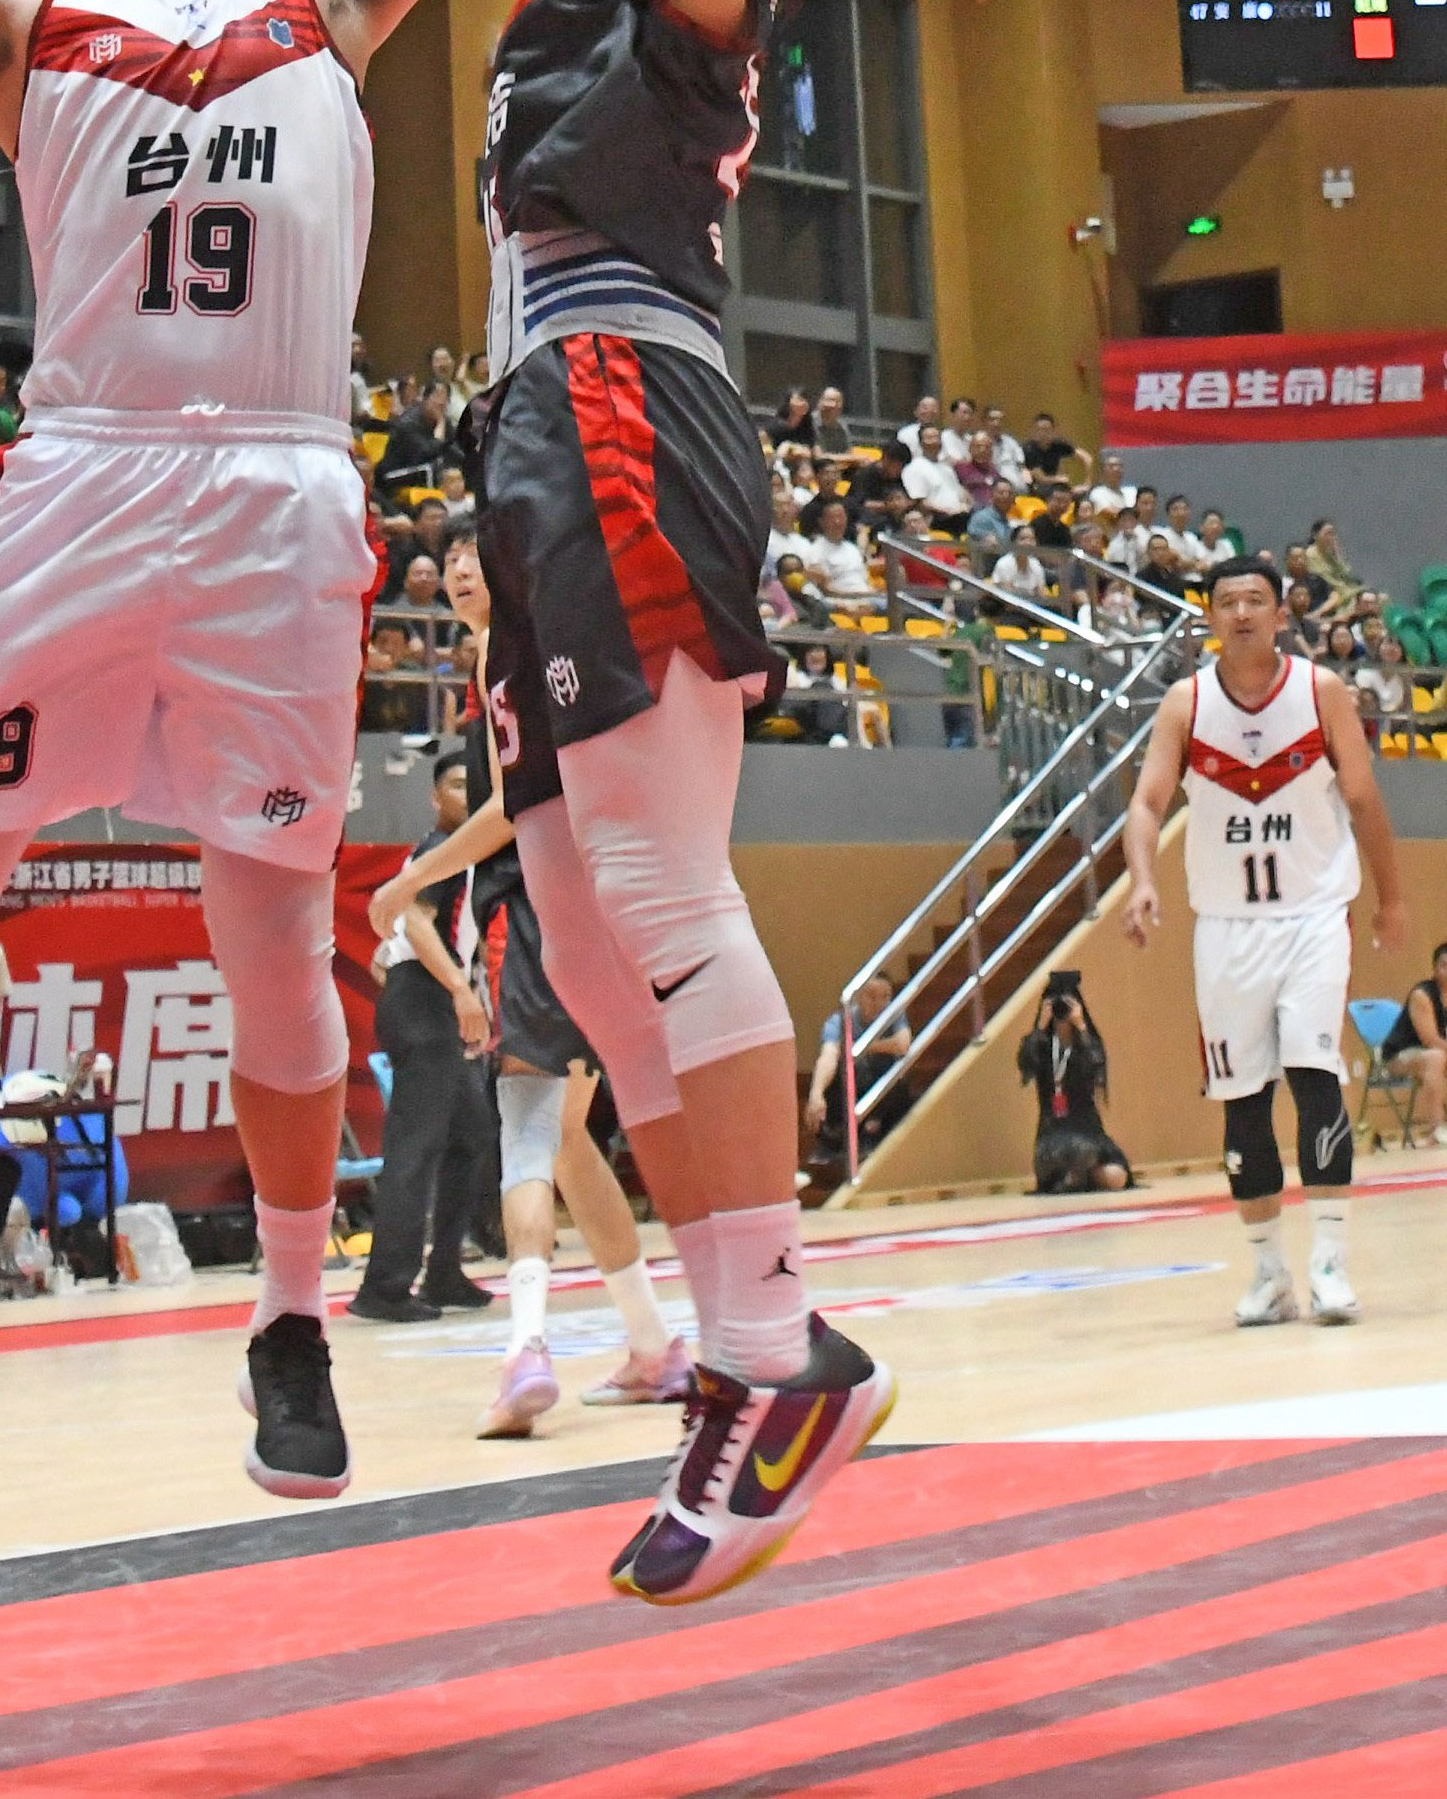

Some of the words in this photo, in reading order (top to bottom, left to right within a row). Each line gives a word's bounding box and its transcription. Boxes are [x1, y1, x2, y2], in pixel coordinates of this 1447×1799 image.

[126, 125, 277, 197] 台州
[135, 201, 257, 317] 19
[1134, 364, 1425, 411] 聚合生命能量
[1225, 813, 1292, 844] 台州
[1243, 851, 1282, 903] 11
